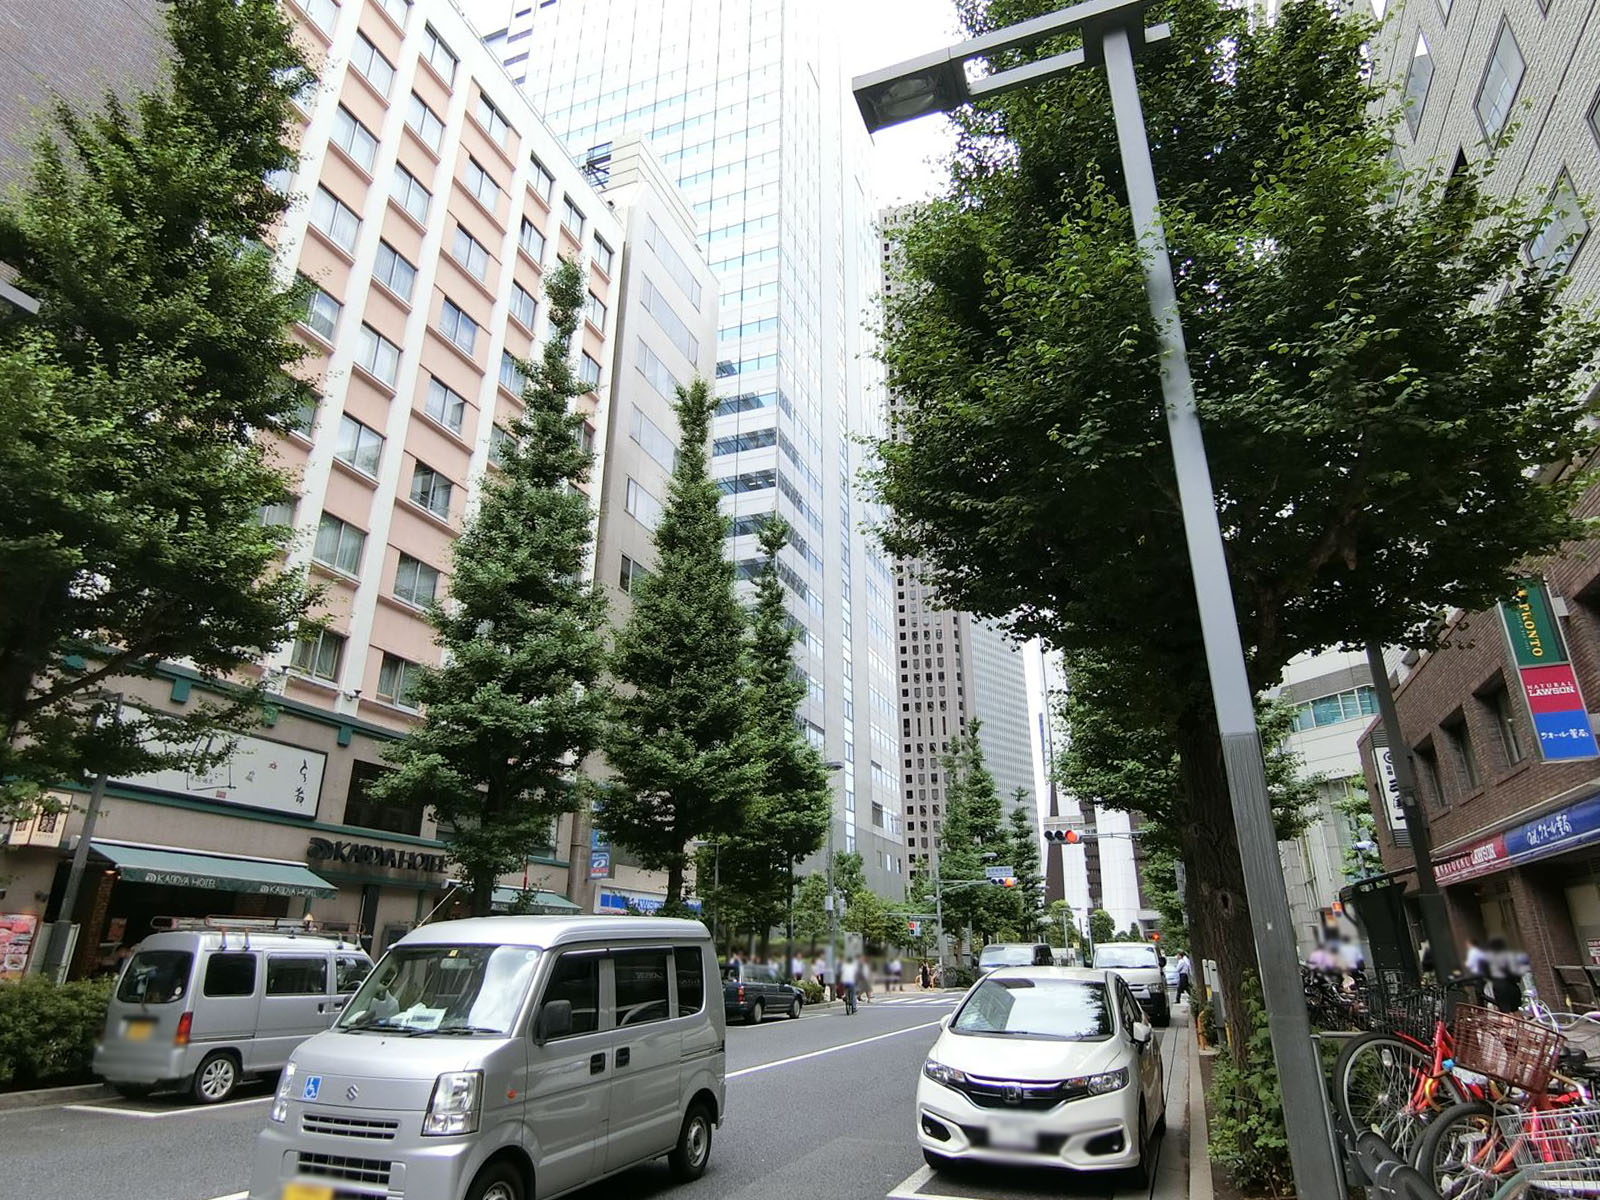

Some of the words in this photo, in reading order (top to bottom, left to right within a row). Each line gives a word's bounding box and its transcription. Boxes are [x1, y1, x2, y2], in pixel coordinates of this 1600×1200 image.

[1518, 602, 1544, 657] PRONTO
[1526, 681, 1574, 690] NATURAL
[1528, 686, 1576, 697] LAWSON
[333, 840, 397, 868] KADOYA
[397, 850, 449, 874] HOTEL
[157, 873, 190, 886] KADOYA
[191, 877, 217, 888] HOTEL
